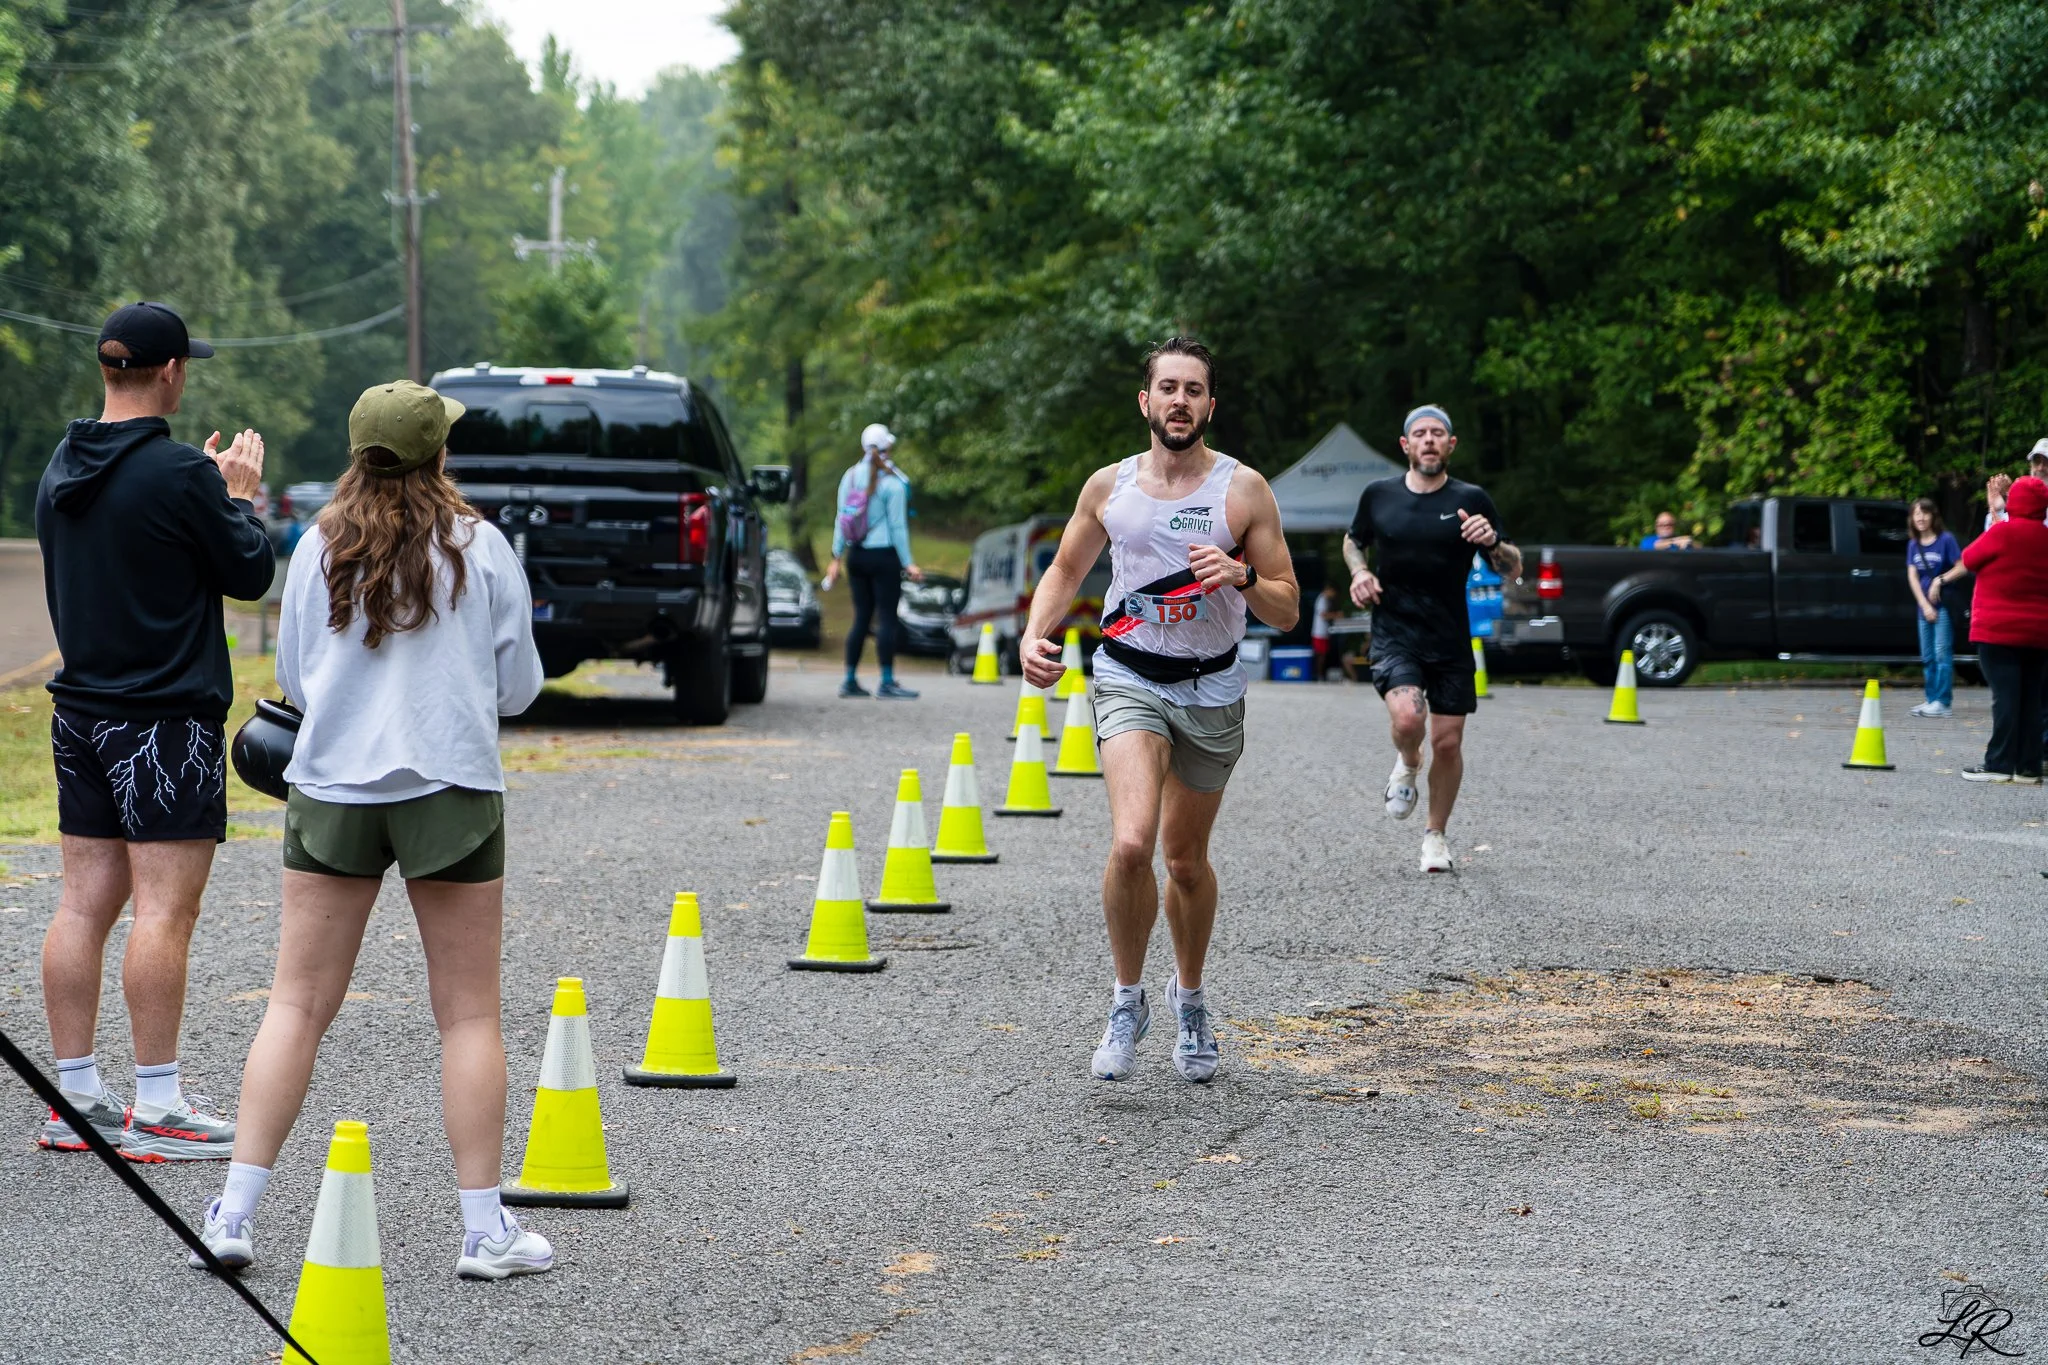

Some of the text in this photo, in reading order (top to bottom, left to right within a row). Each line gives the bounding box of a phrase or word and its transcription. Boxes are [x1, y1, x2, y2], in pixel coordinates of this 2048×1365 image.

[1181, 528, 1211, 536] OUTDOORS
[1182, 517, 1213, 532] GRIVET
[1156, 603, 1198, 623] 150
[140, 1126, 209, 1141] ALTRA
